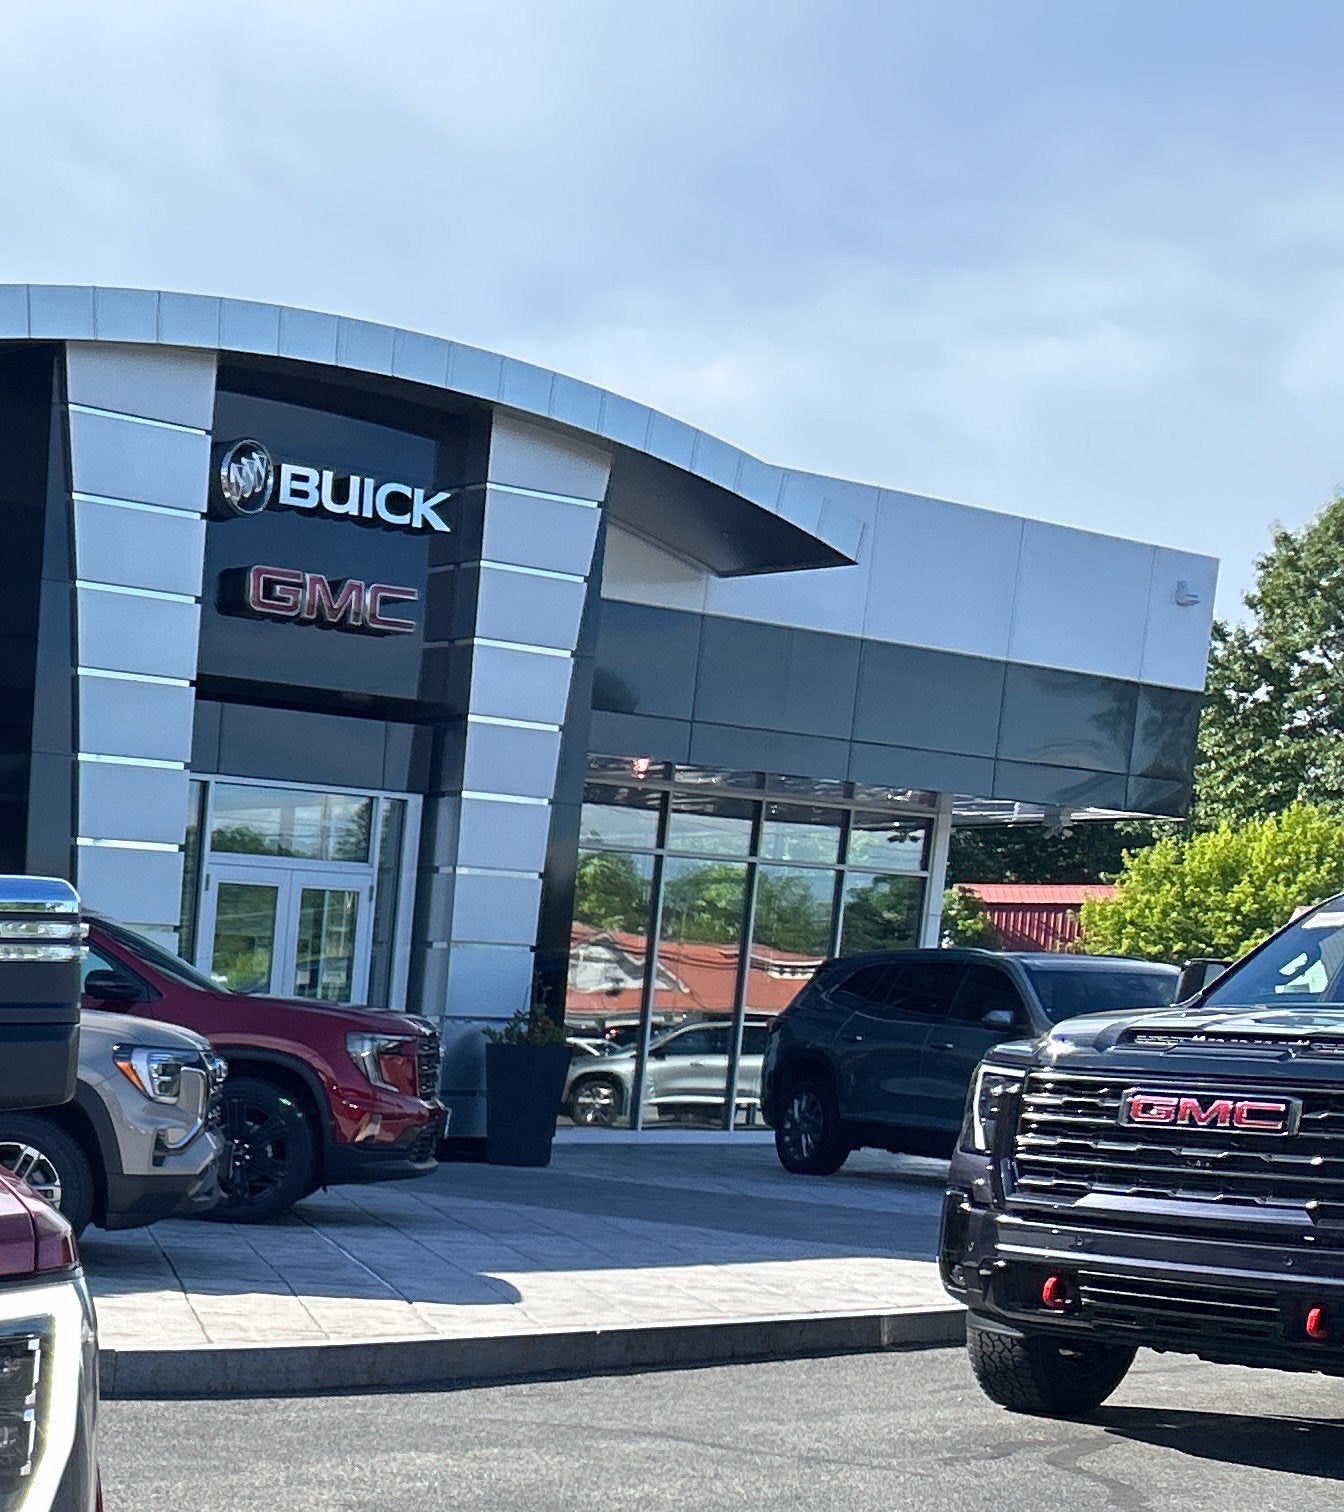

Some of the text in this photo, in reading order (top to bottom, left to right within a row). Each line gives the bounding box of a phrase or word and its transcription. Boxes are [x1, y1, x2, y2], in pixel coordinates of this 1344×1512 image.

[278, 463, 451, 532] BUICK
[249, 564, 418, 632] GMC
[1129, 1094, 1286, 1130] GMC
